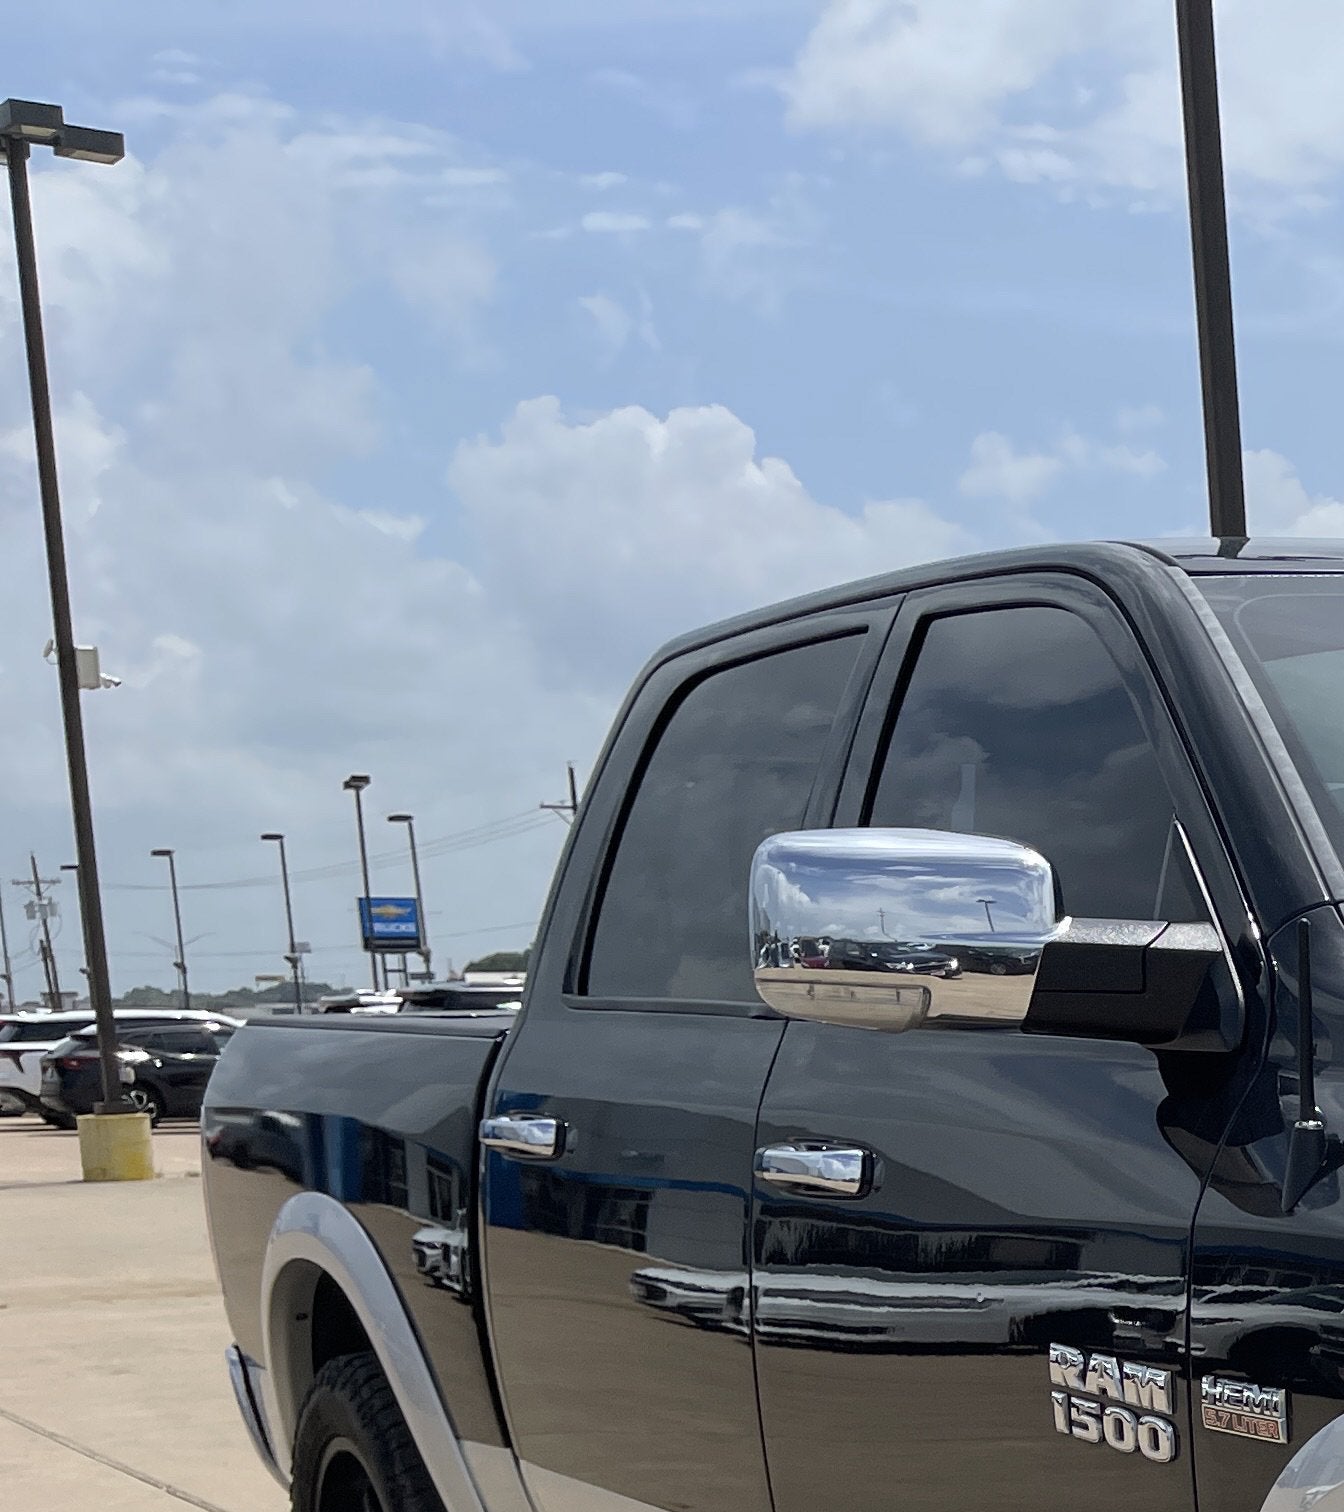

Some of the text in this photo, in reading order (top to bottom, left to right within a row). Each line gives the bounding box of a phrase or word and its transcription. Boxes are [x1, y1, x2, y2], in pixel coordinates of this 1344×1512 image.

[1050, 1342, 1174, 1415] RAM
[1201, 1375, 1286, 1418] HEMI
[1051, 1391, 1176, 1463] 1500
